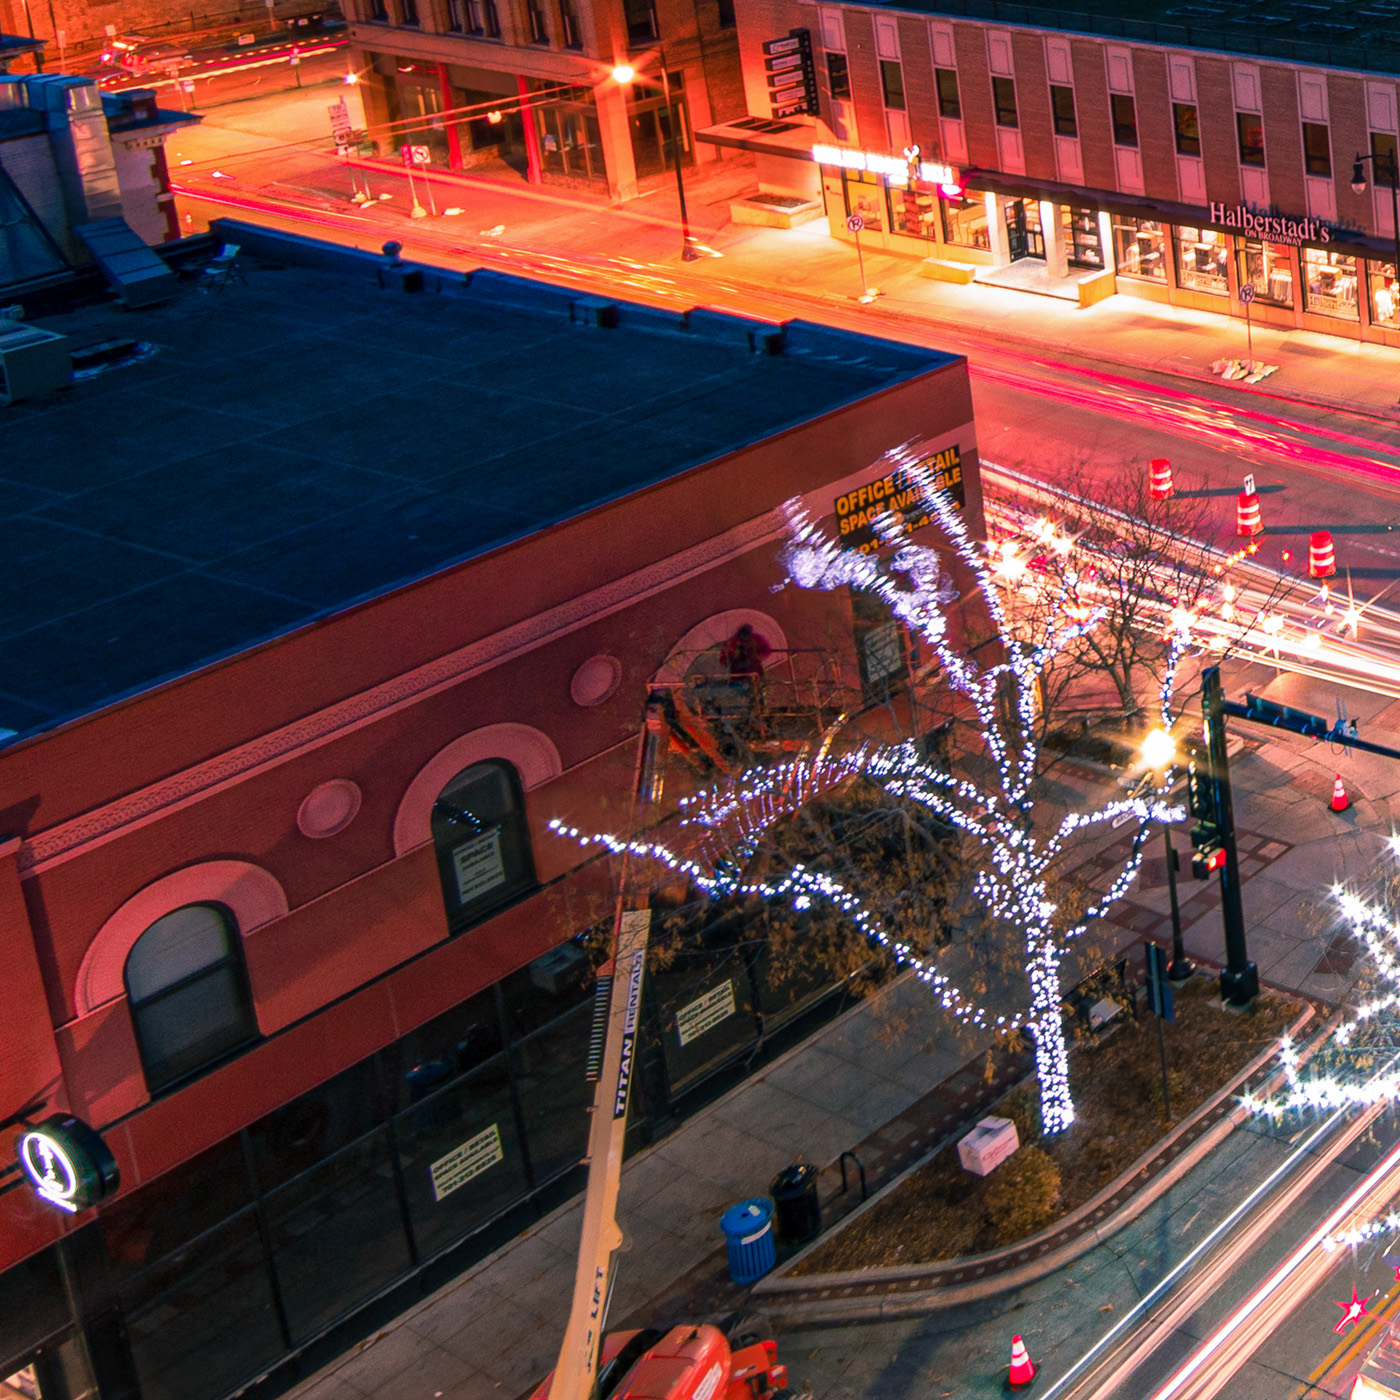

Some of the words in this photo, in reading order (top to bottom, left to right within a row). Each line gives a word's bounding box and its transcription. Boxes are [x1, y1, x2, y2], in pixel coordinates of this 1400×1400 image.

[1210, 201, 1330, 243] Halberstadt's
[1245, 228, 1257, 238] ON
[1258, 231, 1302, 247] BROADWAY
[836, 476, 896, 516] OFFICE
[906, 448, 961, 485] TAIL
[840, 502, 886, 535] SPACE
[616, 1038, 633, 1115] TITAN
